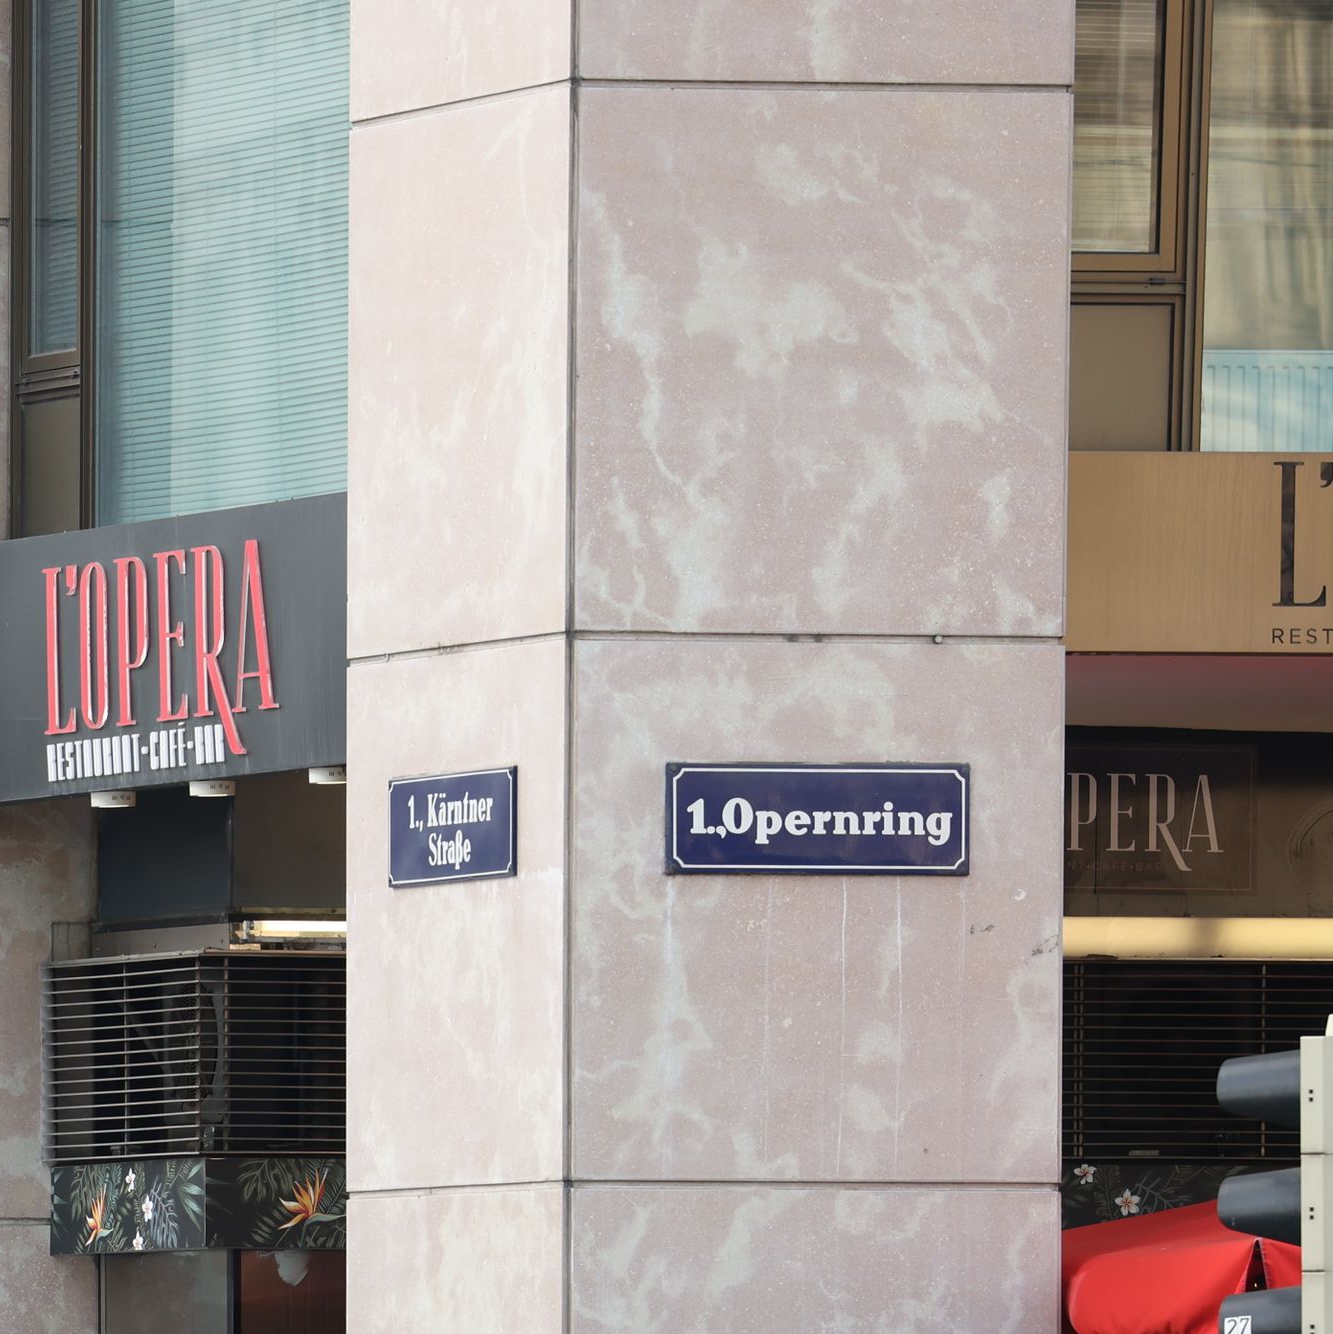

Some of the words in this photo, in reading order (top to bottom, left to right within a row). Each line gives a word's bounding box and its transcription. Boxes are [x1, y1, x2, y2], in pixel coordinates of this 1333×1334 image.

[41, 539, 280, 755] L'OPERA
[427, 791, 493, 828] Kärntner
[428, 829, 471, 870] Straße
